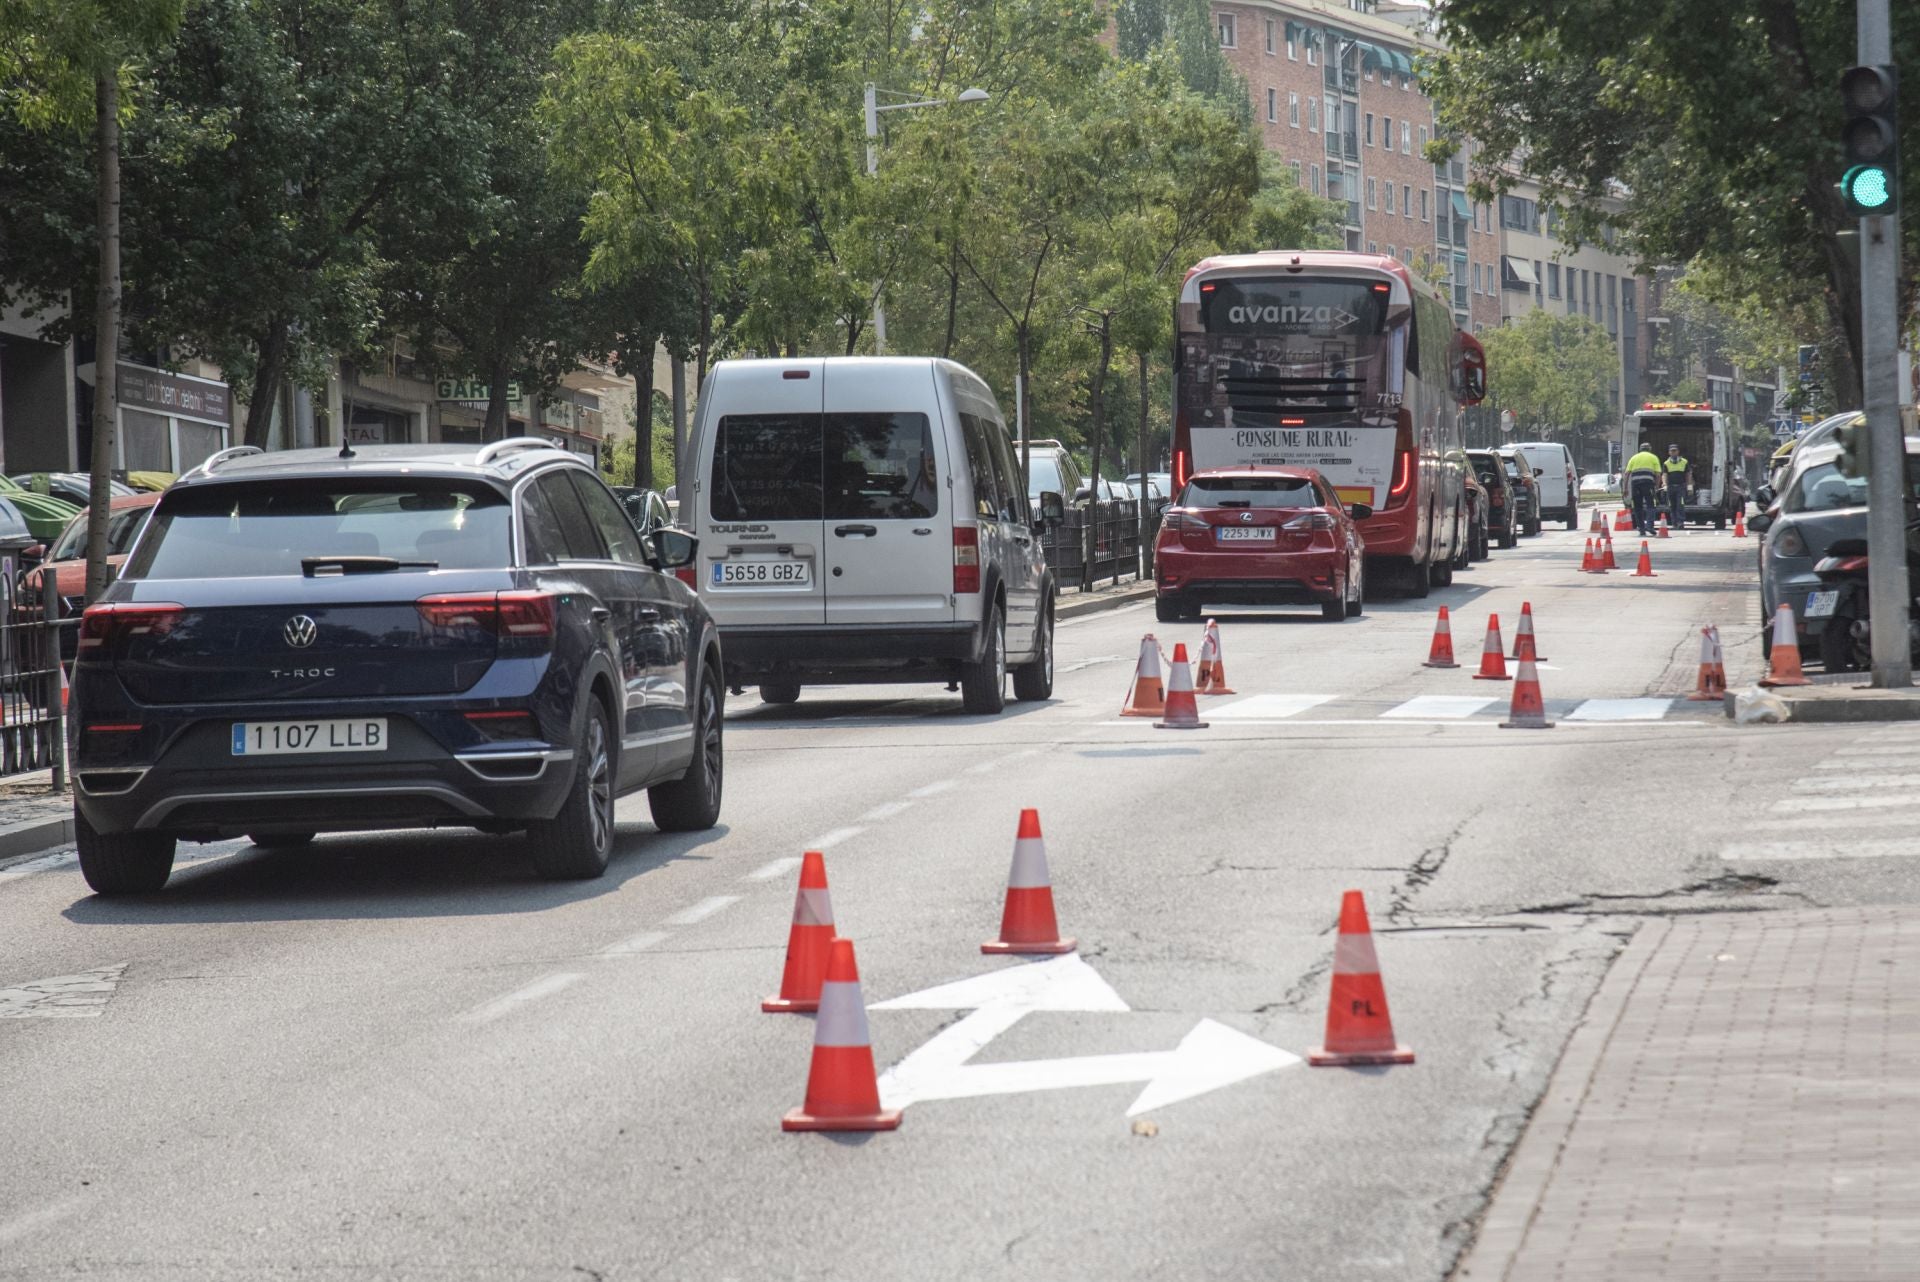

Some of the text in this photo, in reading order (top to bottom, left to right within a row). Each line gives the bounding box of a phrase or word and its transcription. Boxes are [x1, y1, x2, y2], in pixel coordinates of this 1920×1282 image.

[1228, 305, 1331, 323] avanza
[1376, 392, 1402, 405] 7713
[1236, 430, 1352, 447] CONSUME RURAL
[709, 525, 768, 533] TOURNEO
[1224, 529, 1272, 538] 2253 JWX
[725, 565, 804, 580] 5658 GBZ
[271, 668, 336, 678] T-ROC
[255, 724, 319, 749] 1107
[330, 723, 380, 747] LLB
[1352, 1000, 1377, 1016] PL
